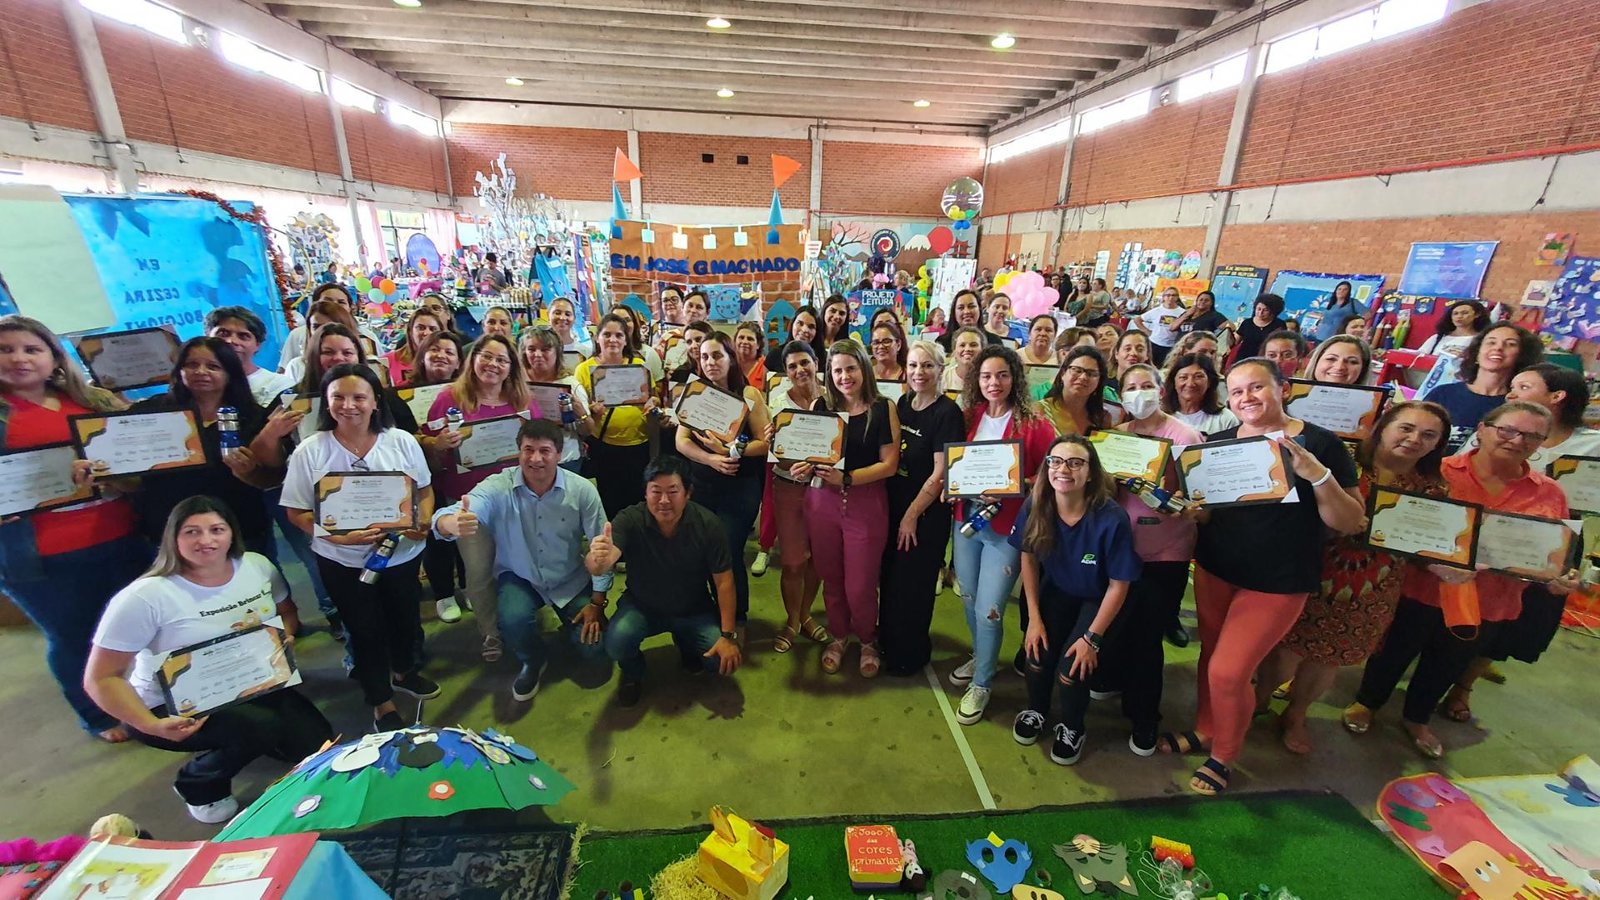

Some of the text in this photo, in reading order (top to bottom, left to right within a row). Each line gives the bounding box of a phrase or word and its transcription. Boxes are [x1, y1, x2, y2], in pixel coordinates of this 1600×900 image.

[610, 253, 640, 271] EM
[862, 290, 895, 298] PROJETO
[862, 298, 894, 306] LEITURA
[199, 604, 238, 618] Exposição
[858, 847, 893, 855] cores
